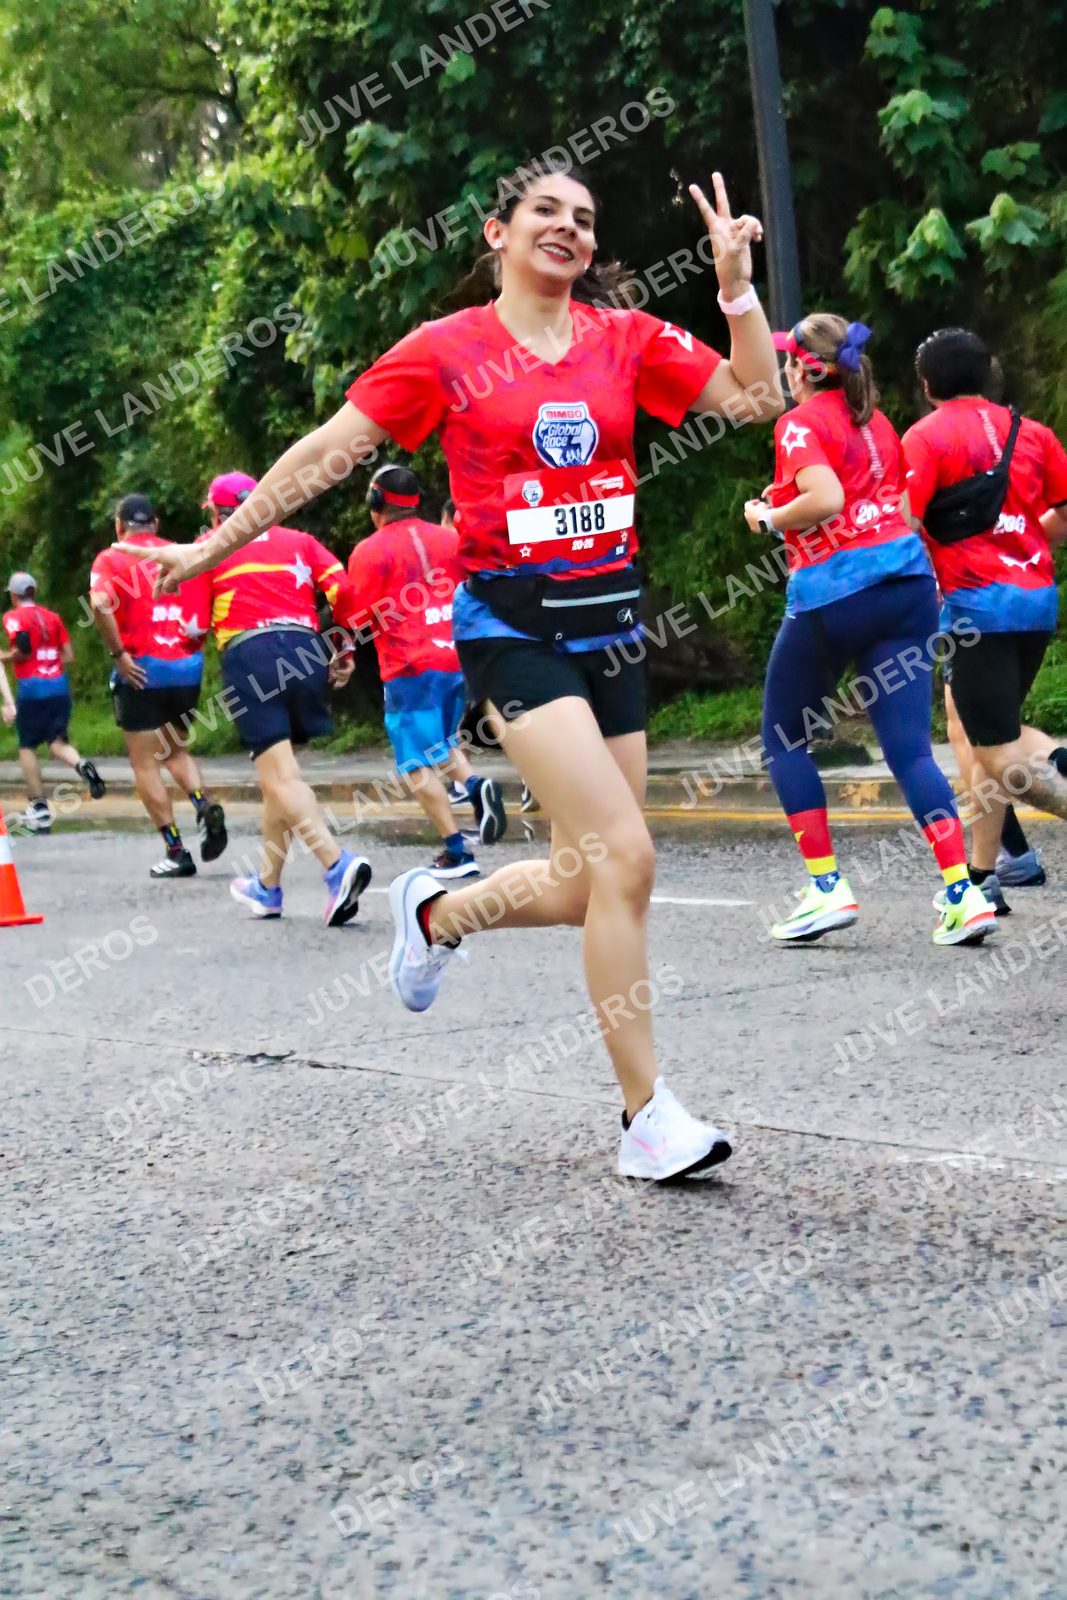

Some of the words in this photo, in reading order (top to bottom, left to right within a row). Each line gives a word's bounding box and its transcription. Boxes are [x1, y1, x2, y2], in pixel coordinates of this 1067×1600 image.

[546, 410, 582, 419] BIMBO
[548, 424, 582, 437] Global
[543, 436, 568, 448] Race
[554, 502, 605, 536] 3188
